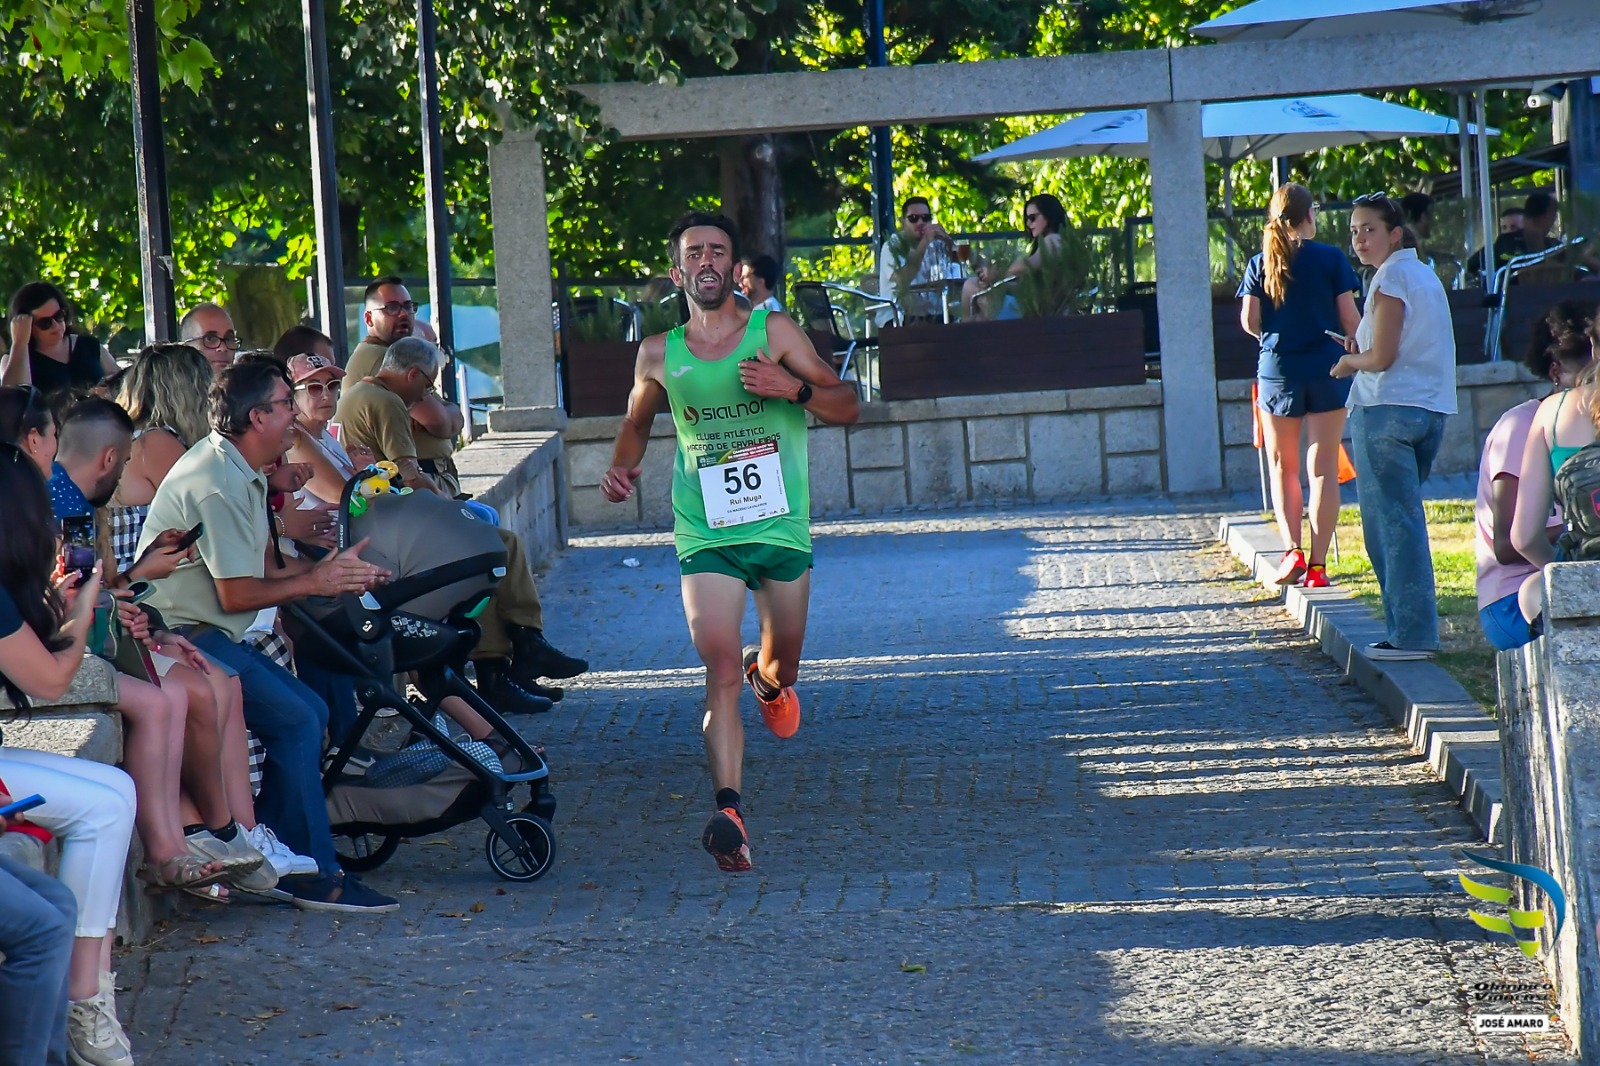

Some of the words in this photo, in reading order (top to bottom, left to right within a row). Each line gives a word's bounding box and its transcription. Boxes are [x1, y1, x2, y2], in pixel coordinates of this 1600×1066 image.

[696, 433, 721, 441] CLUBE
[724, 427, 765, 439] ATLÉTICO
[687, 443, 714, 453] MACEDO
[717, 441, 729, 450] DE
[724, 463, 762, 495] 56
[729, 497, 742, 506] Rui
[743, 494, 762, 503] Muga
